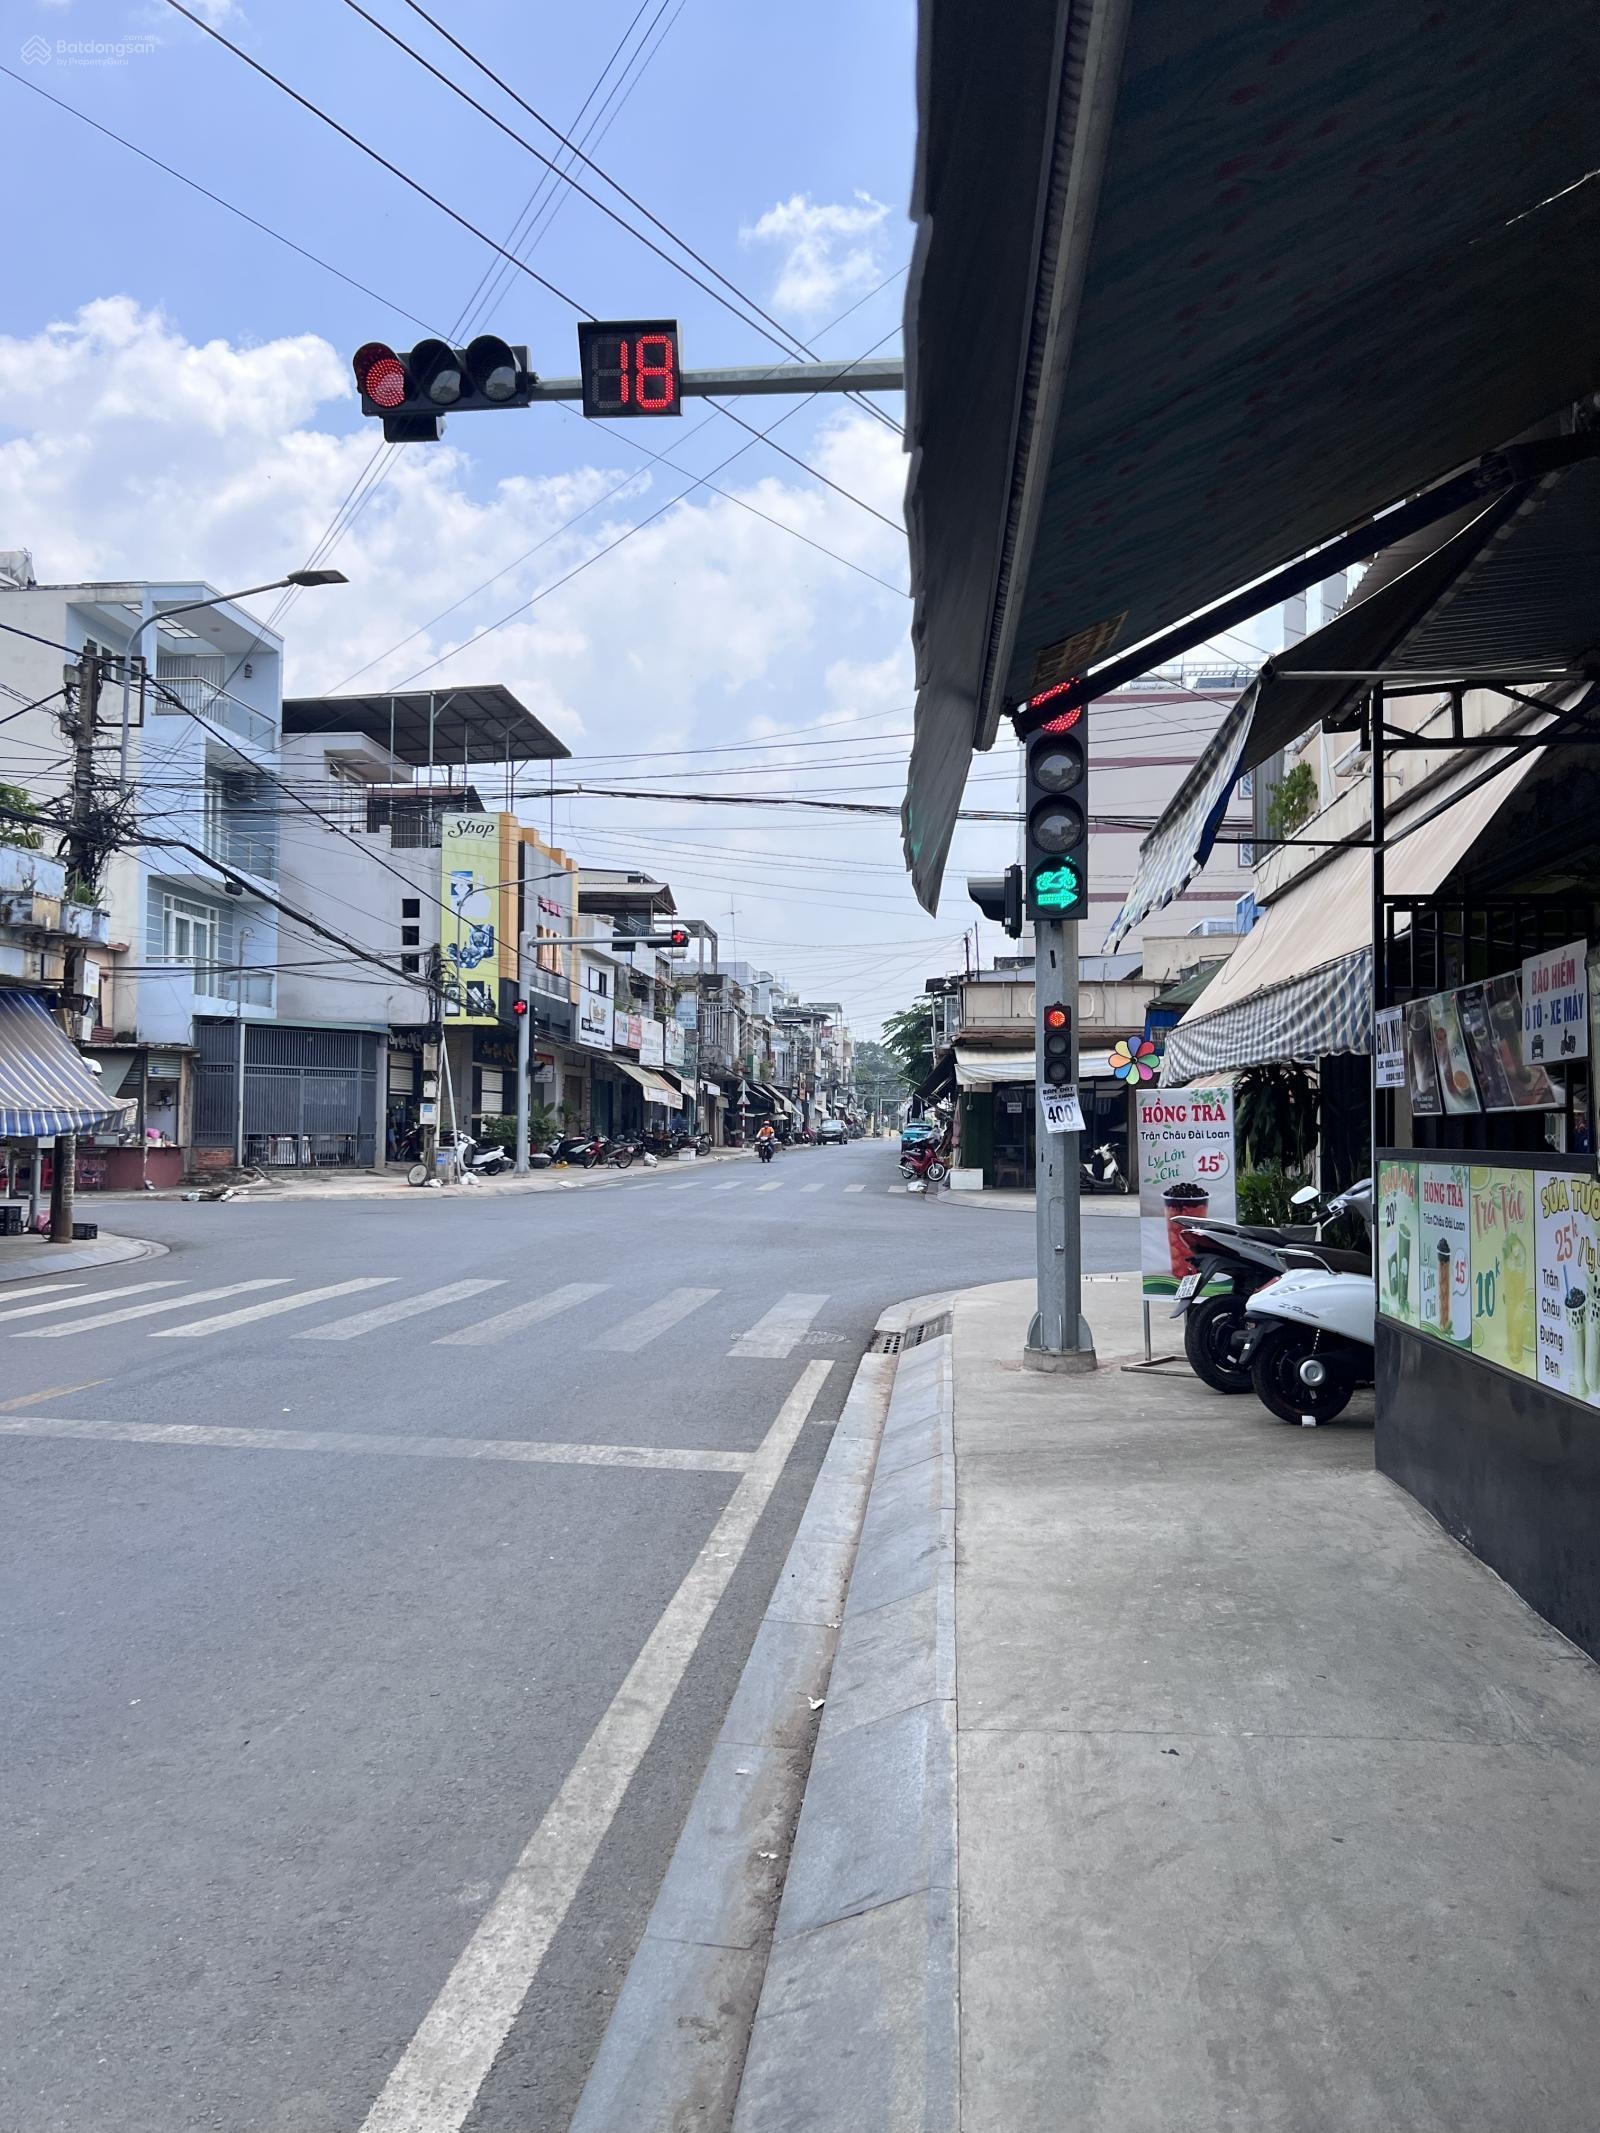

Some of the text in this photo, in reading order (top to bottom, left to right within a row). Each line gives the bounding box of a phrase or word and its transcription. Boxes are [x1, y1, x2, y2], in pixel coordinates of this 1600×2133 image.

[620, 335, 673, 408] 18
[448, 819, 496, 839] Shop
[1551, 950, 1576, 989] HIỂM
[1525, 1002, 1531, 1031] Ô
[1532, 999, 1543, 1029] TÔ
[1550, 999, 1562, 1026] XE
[1563, 988, 1584, 1023] MÁY
[1142, 1097, 1226, 1123] HỒNG TRÀ
[1141, 1129, 1230, 1140] Trân Châu Đài Loan
[1148, 1148, 1185, 1168] Ly Lớn
[1423, 1171, 1464, 1207] HỒNG TRÀ
[1540, 1176, 1570, 1219] SỮA
[1423, 1212, 1433, 1225] Trân
[1433, 1215, 1445, 1228] Châu
[1454, 1219, 1466, 1231] Loan
[1472, 1175, 1525, 1242] Trà Tắc
[1542, 1268, 1560, 1288] Trân
[1541, 1296, 1561, 1319] Châu
[1539, 1324, 1564, 1353] Đường
[1543, 1355, 1560, 1375] Đen
